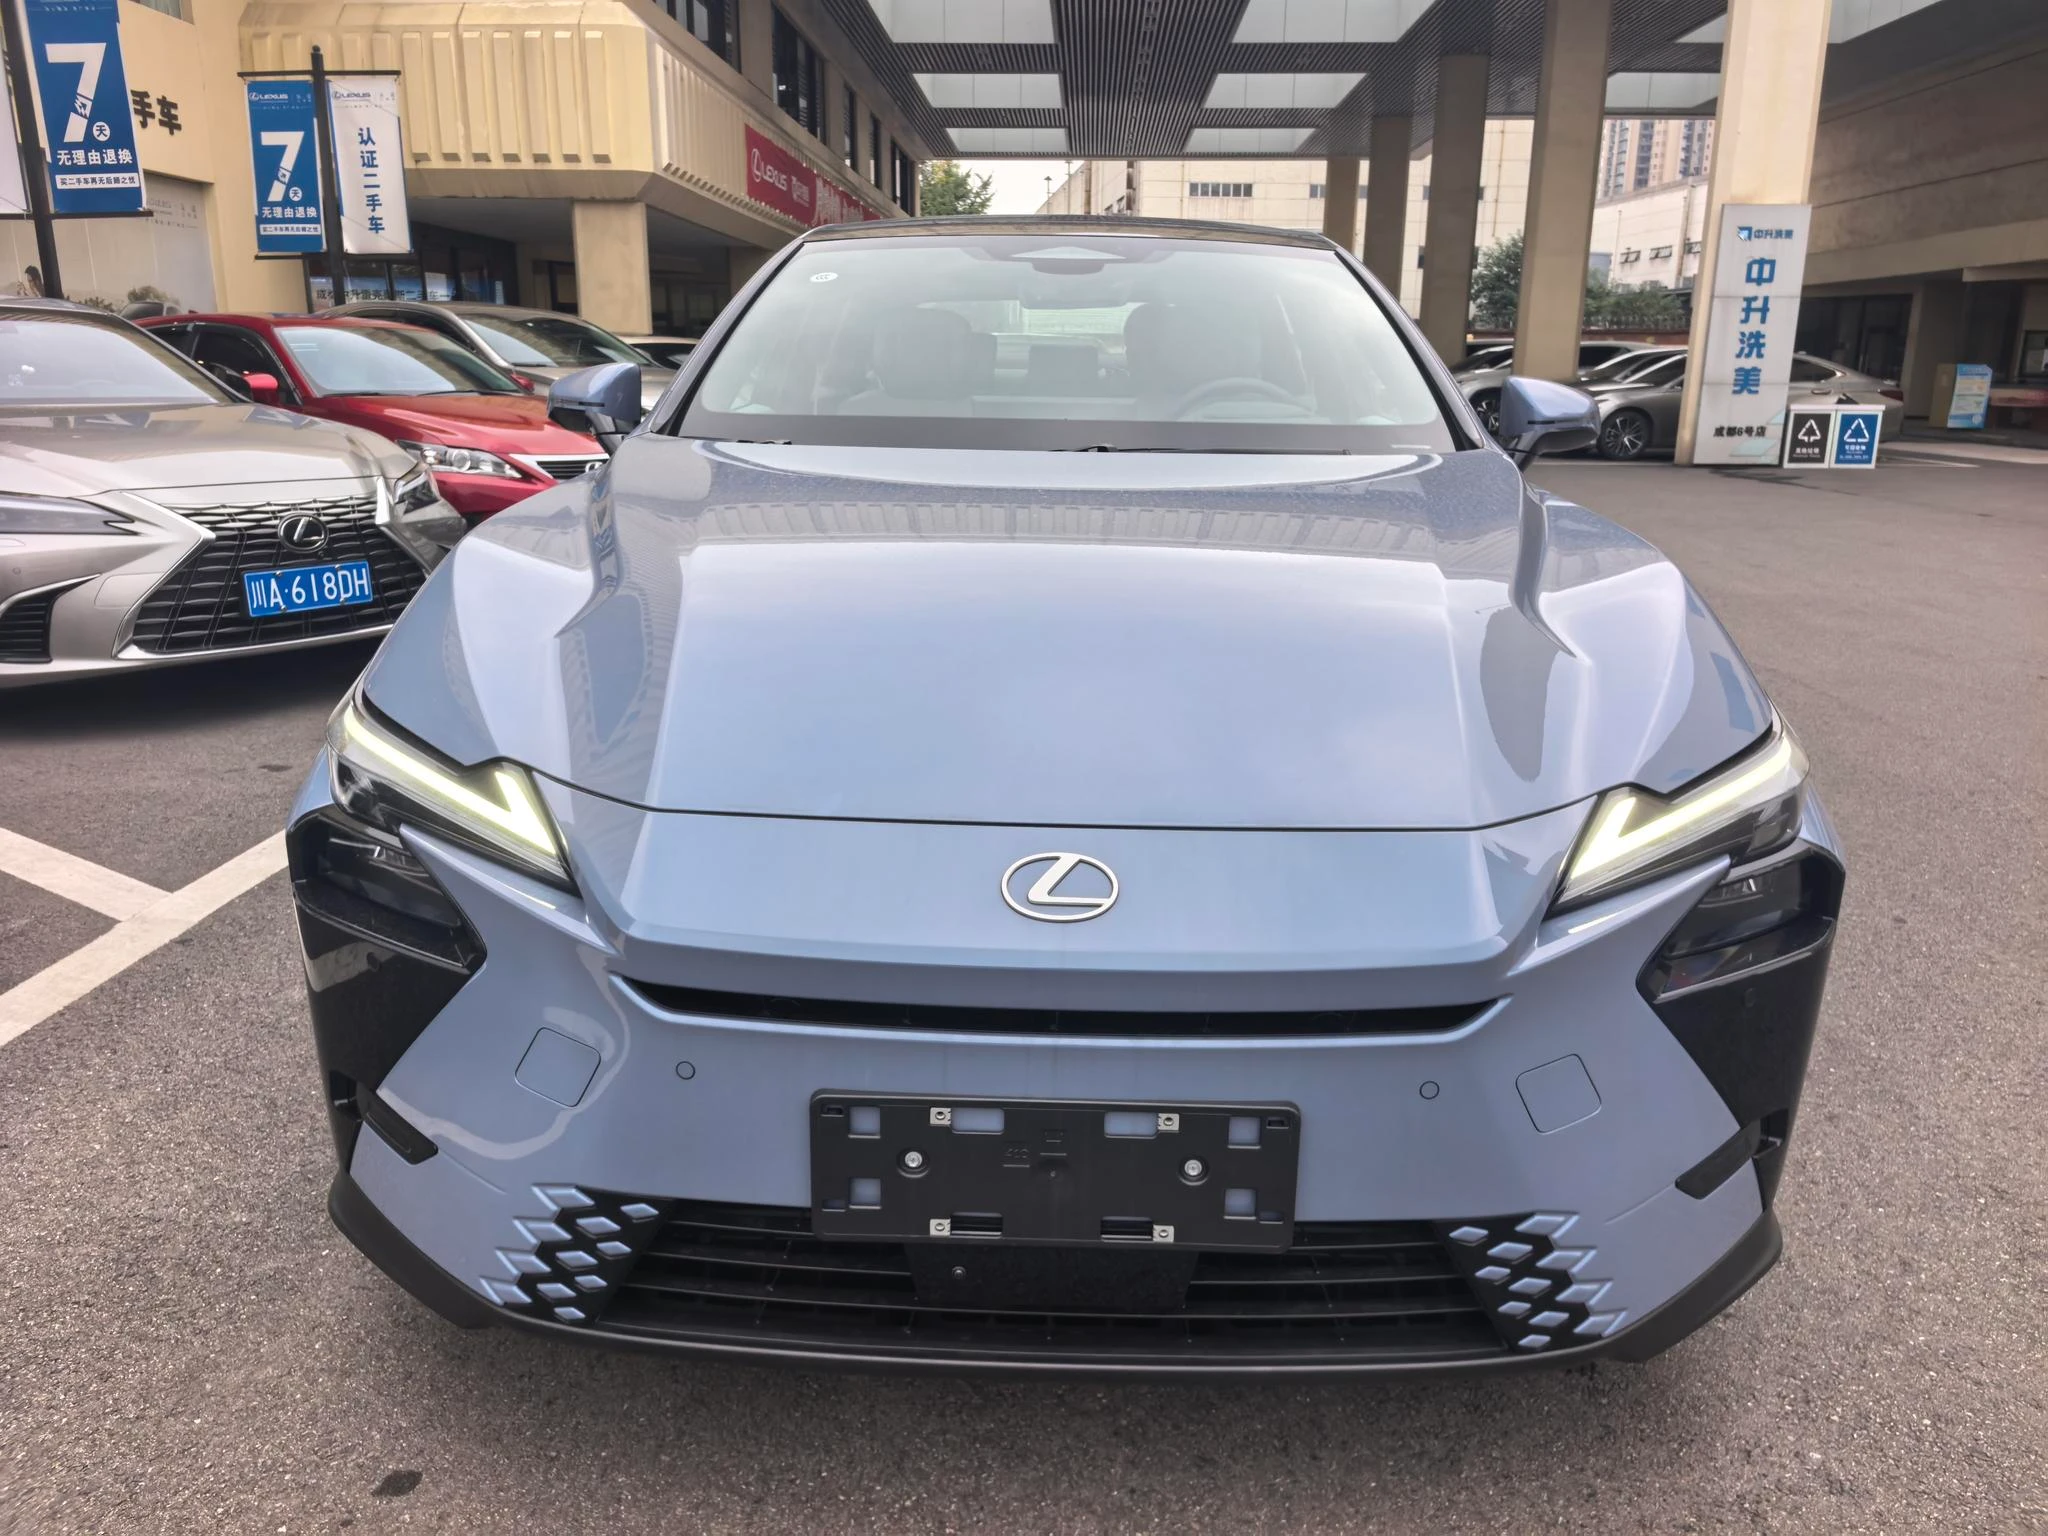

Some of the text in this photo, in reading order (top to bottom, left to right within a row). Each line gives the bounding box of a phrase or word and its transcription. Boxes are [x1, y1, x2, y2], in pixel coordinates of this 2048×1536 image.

[45, 42, 107, 142] 7
[259, 92, 289, 100] LEXUS
[95, 124, 108, 138] 天
[57, 149, 133, 166] 无理由退换
[261, 131, 305, 202] 7
[358, 127, 385, 234] 认证二手车
[761, 161, 788, 192] LEXUS
[291, 189, 300, 199] 天
[262, 206, 318, 218] 无理由退换
[1753, 229, 1793, 239] 中升洗美
[1732, 257, 1776, 395] 中升洗美
[1713, 426, 1767, 438] 成都6号店
